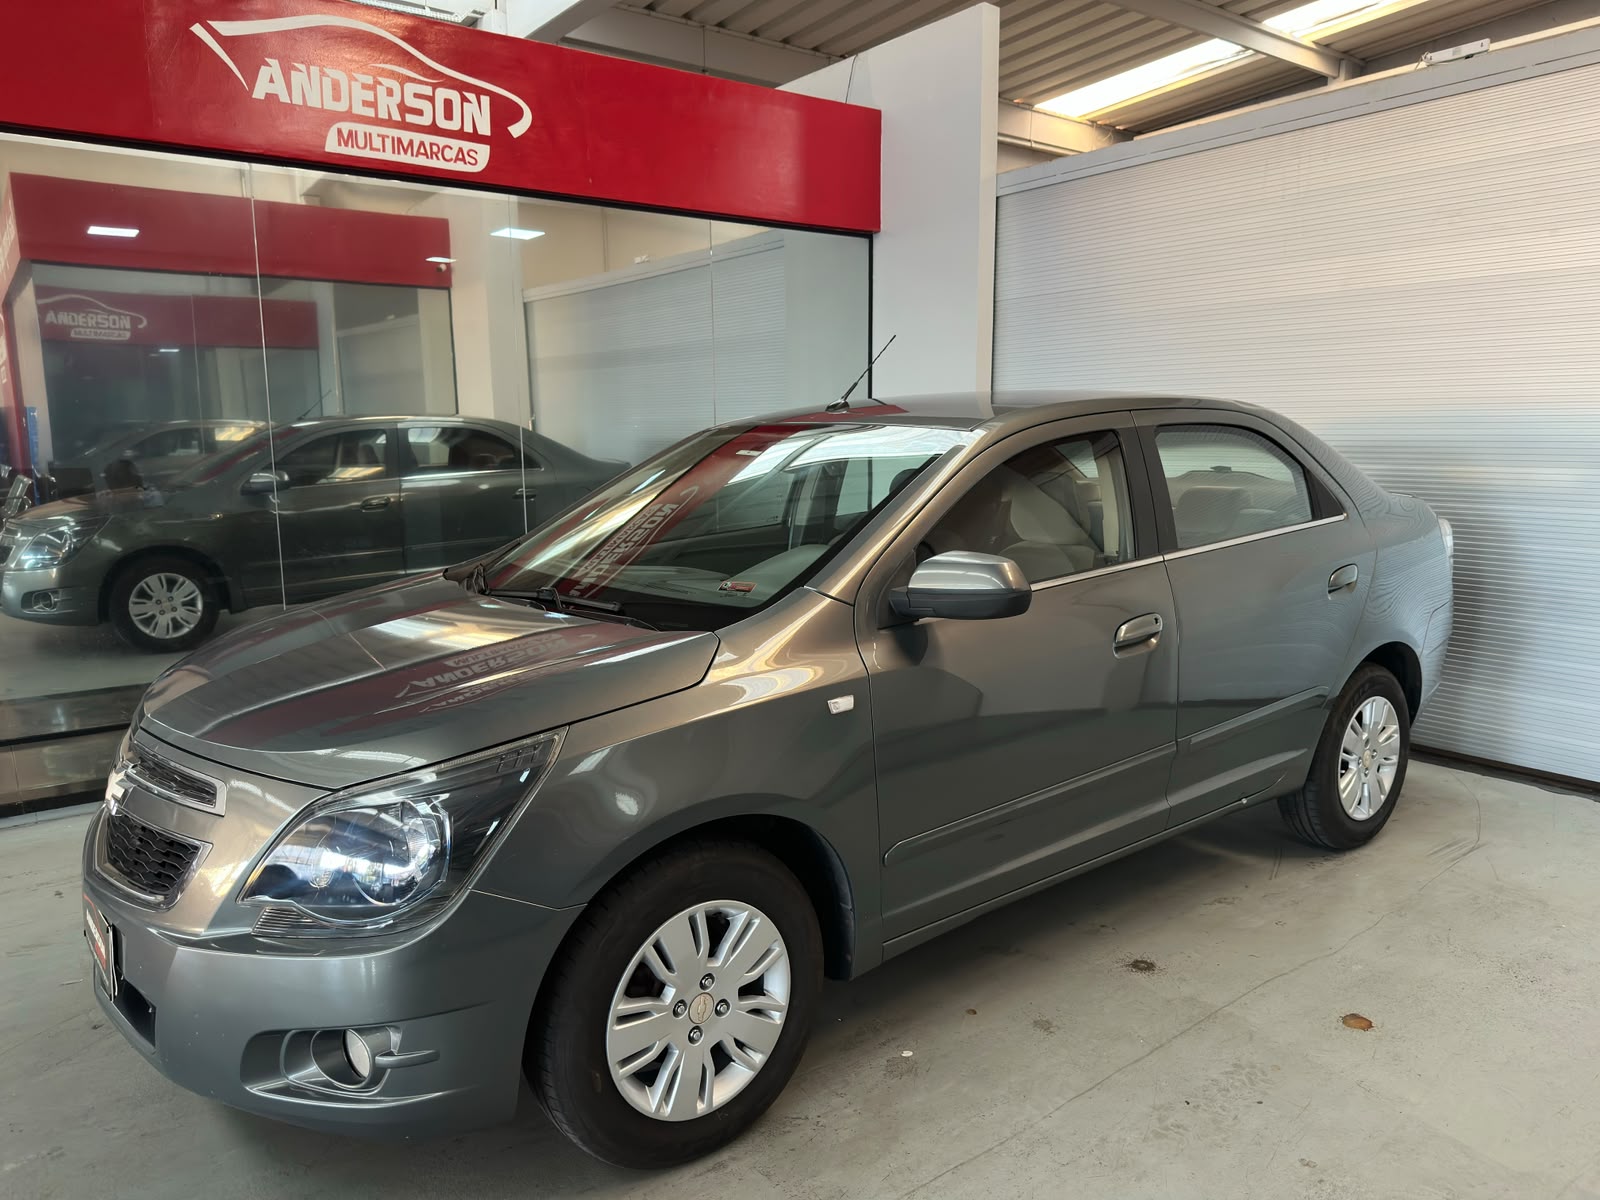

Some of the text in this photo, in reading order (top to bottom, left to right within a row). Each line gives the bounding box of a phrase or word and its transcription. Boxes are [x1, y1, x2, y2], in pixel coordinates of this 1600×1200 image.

[252, 58, 491, 136] ANDERSON
[337, 128, 479, 166] MULTIMARCAS
[45, 310, 131, 329] ANDERSON
